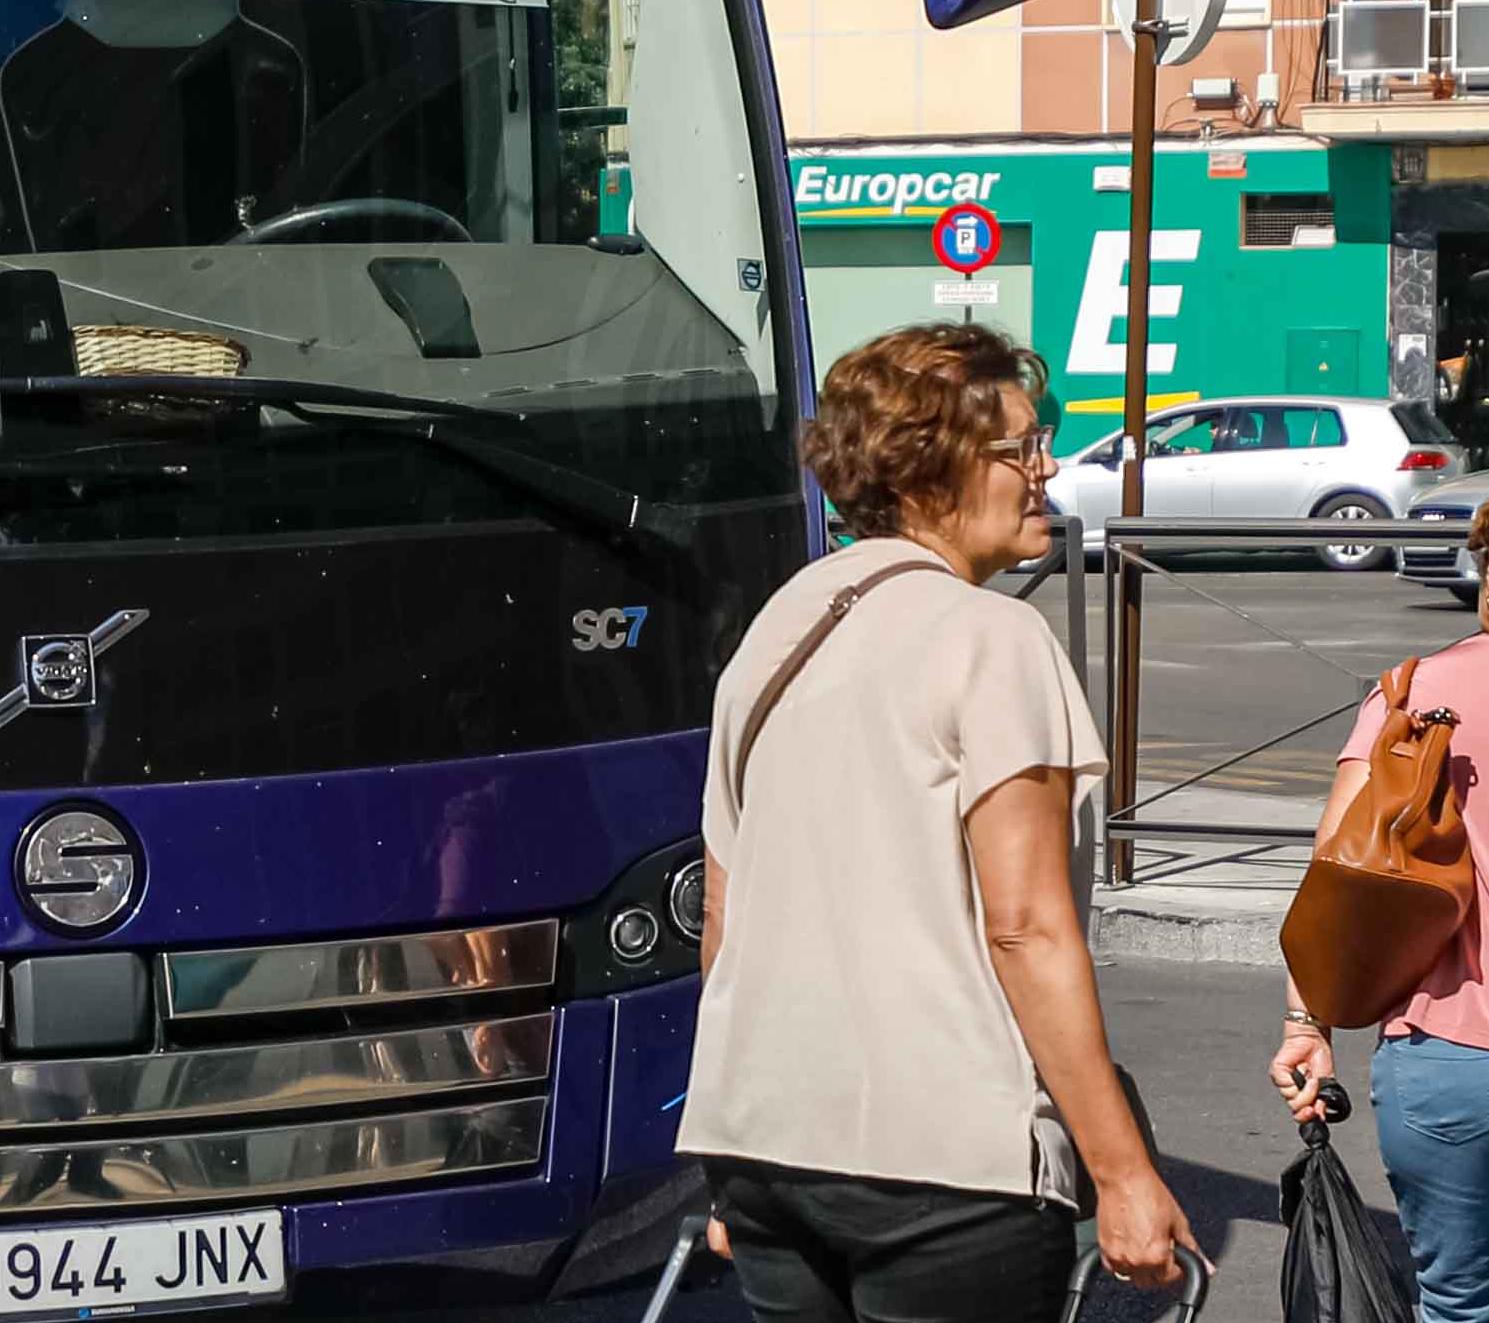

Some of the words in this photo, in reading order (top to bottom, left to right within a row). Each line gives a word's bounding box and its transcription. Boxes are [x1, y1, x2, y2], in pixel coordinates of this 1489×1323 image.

[796, 166, 1001, 215] Europcar
[1065, 228, 1202, 374] E
[572, 605, 648, 652] SC7
[154, 1222, 269, 1290] JNX
